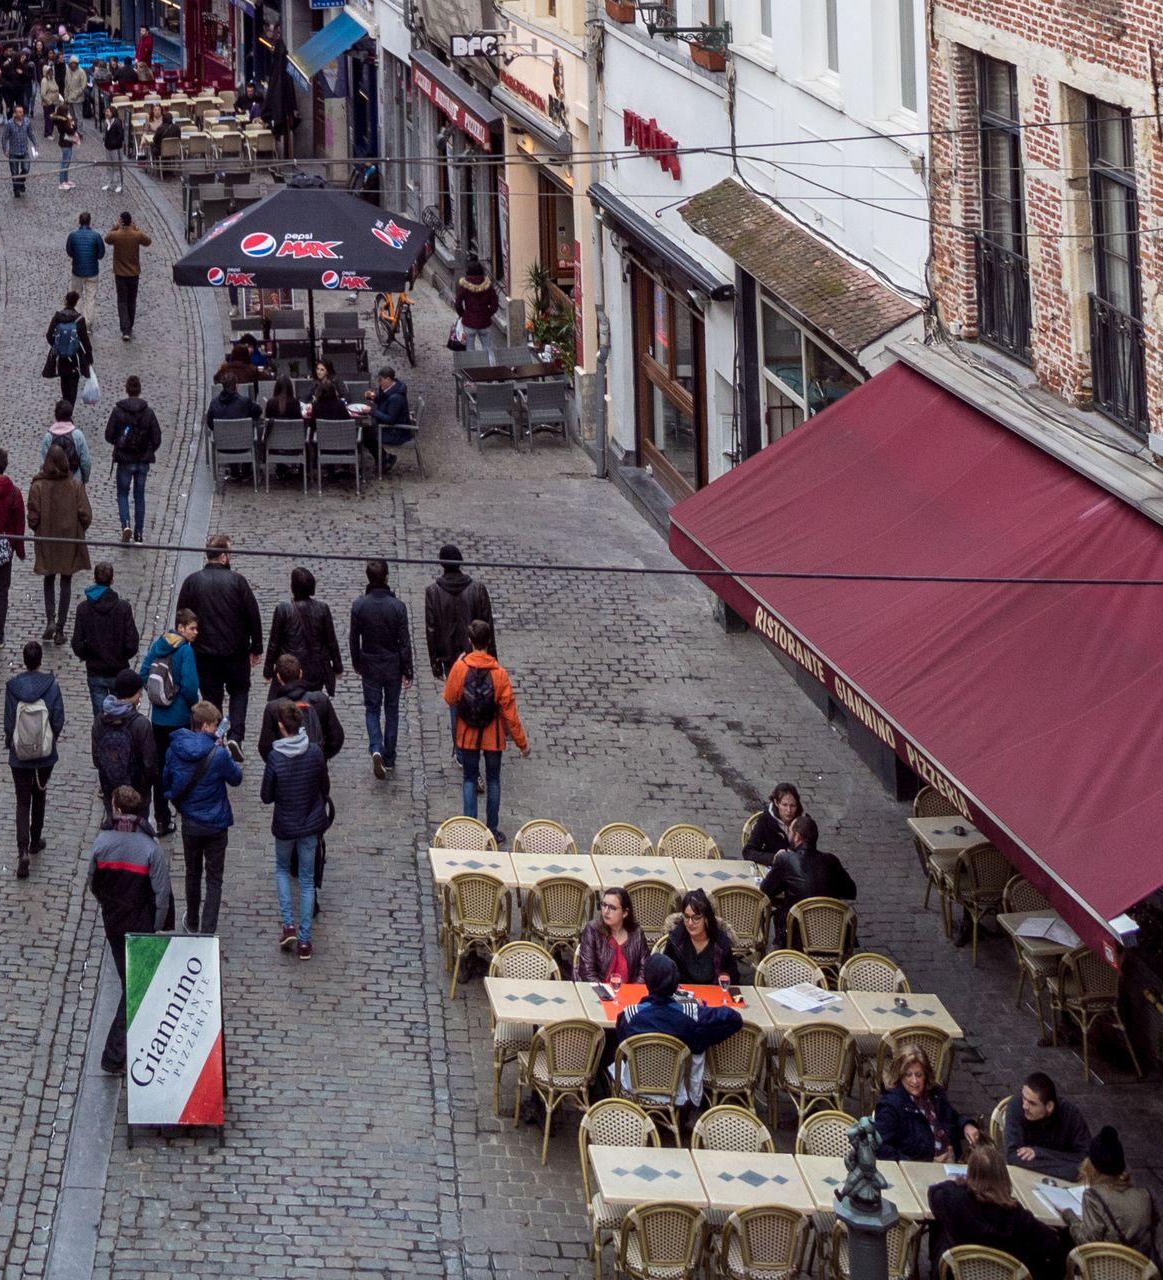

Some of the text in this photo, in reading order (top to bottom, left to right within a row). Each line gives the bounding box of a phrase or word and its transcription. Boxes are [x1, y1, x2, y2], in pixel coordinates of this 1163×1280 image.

[453, 36, 497, 56] BFC
[284, 232, 313, 240] pepsi
[276, 241, 344, 259] MAX
[225, 273, 256, 287] MAX
[340, 276, 372, 290] MAX
[755, 606, 973, 821] RISTORANTE GIANNINO PIZZERIA
[130, 956, 203, 1087] Giannino
[156, 977, 210, 1085] RISTORANTE
[173, 998, 213, 1077] PIZZERIA
